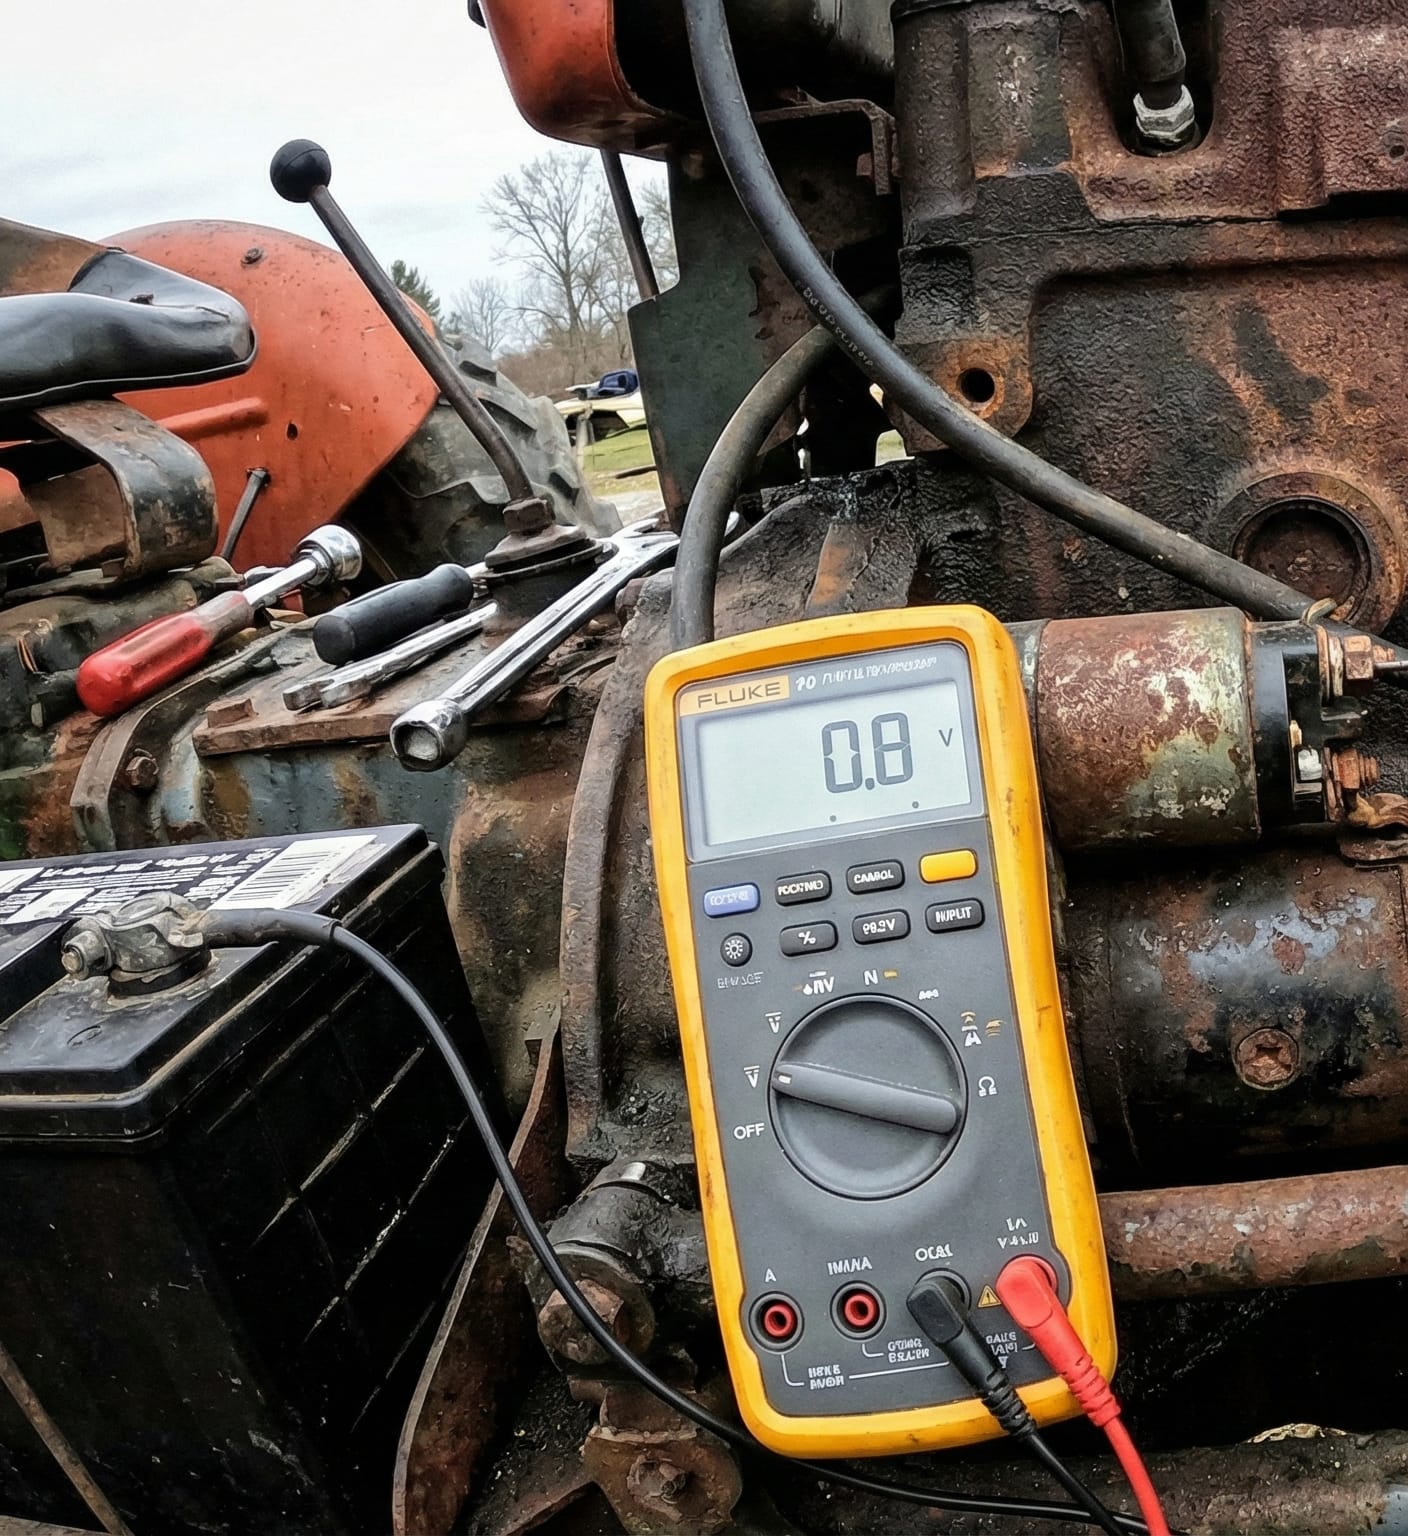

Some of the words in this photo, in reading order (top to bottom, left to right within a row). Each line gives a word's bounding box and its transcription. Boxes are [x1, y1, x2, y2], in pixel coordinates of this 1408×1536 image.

[697, 682, 781, 708] FLUKE
[821, 712, 913, 794] 0.8
[938, 727, 953, 747] V
[733, 1122, 766, 1140] OFF
[765, 1268, 777, 1283] A
